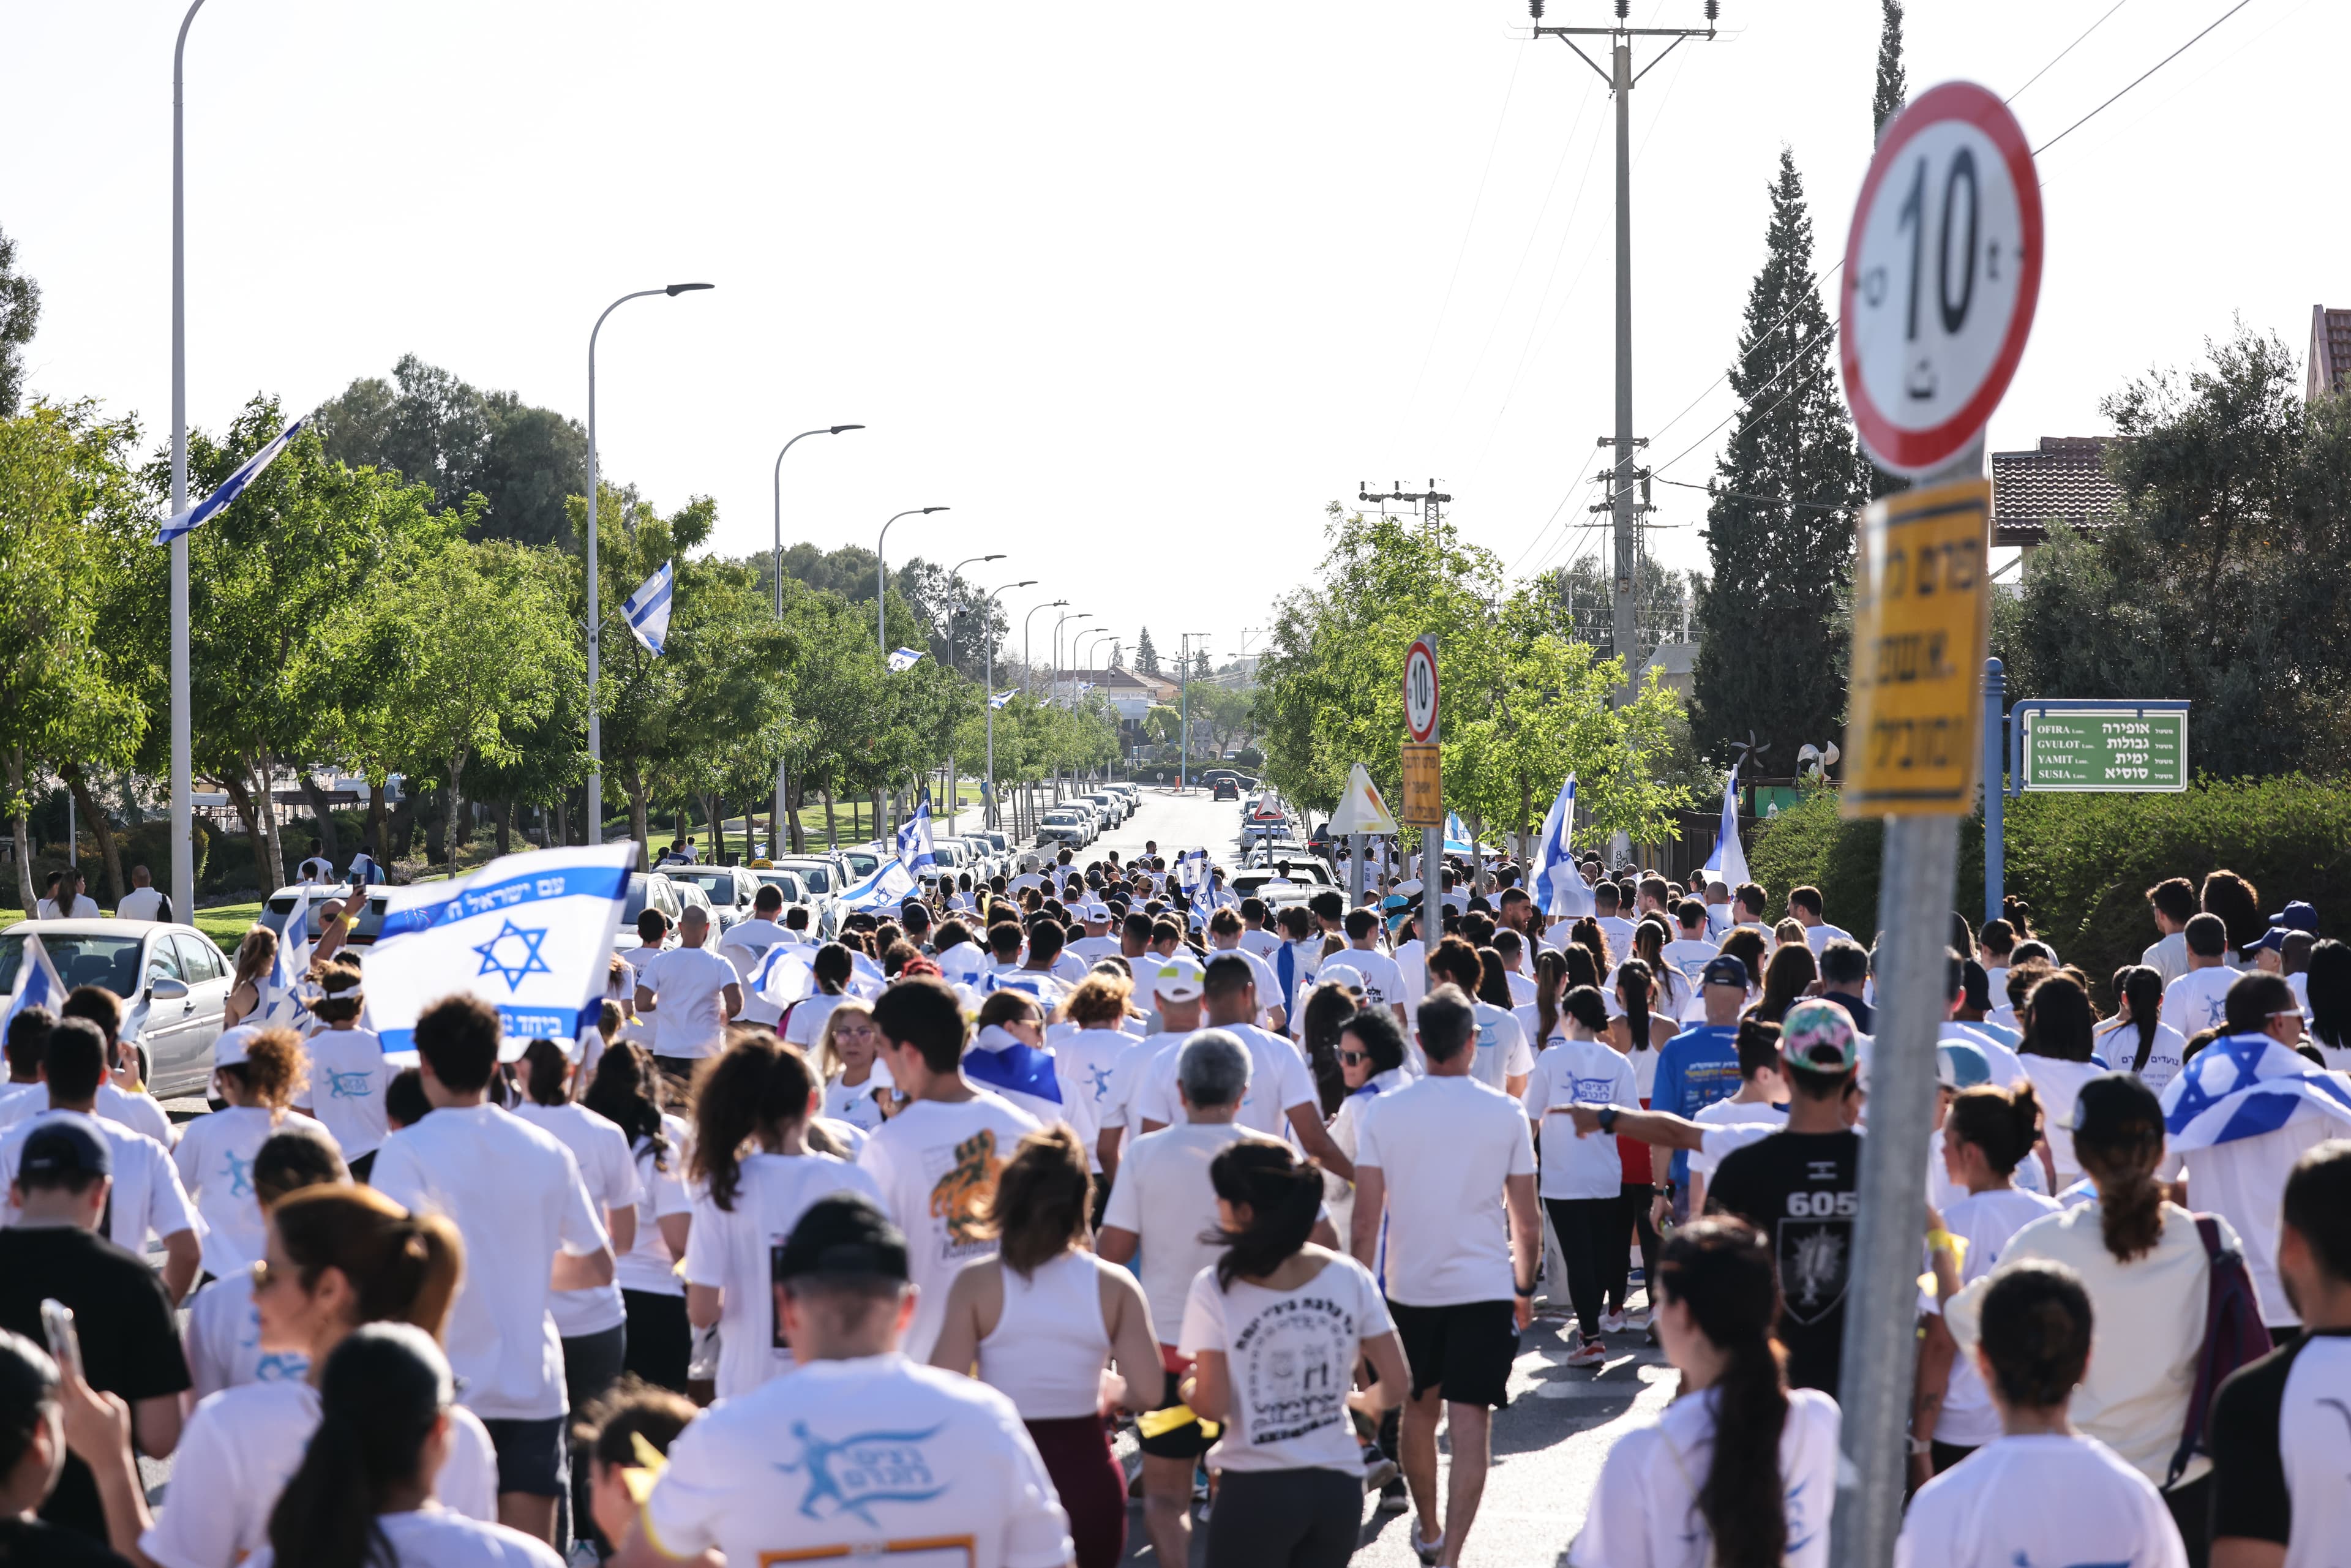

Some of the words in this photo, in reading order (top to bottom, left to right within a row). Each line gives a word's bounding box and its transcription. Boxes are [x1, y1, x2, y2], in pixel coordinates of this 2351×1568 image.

[1897, 146, 1978, 340] 10
[1412, 660, 1427, 710] 10
[2037, 725, 2070, 734] OFIRA
[2102, 723, 2150, 734] אופירה
[2037, 740, 2080, 749] GVULOT
[2106, 735, 2150, 749] גבולות
[2038, 754, 2074, 764] YAMIT
[2115, 752, 2149, 764] ימית
[2038, 770, 2071, 779] SUSIA
[2105, 767, 2149, 779] סוסיא
[536, 876, 565, 897] עם
[464, 882, 531, 913] ישראל
[516, 1015, 563, 1036] ביחד
[2150, 1056, 2180, 1066] צועדים
[1585, 1083, 1610, 1092] רצים
[1581, 1090, 1610, 1100] לזכרם
[1787, 1191, 1858, 1217] 605
